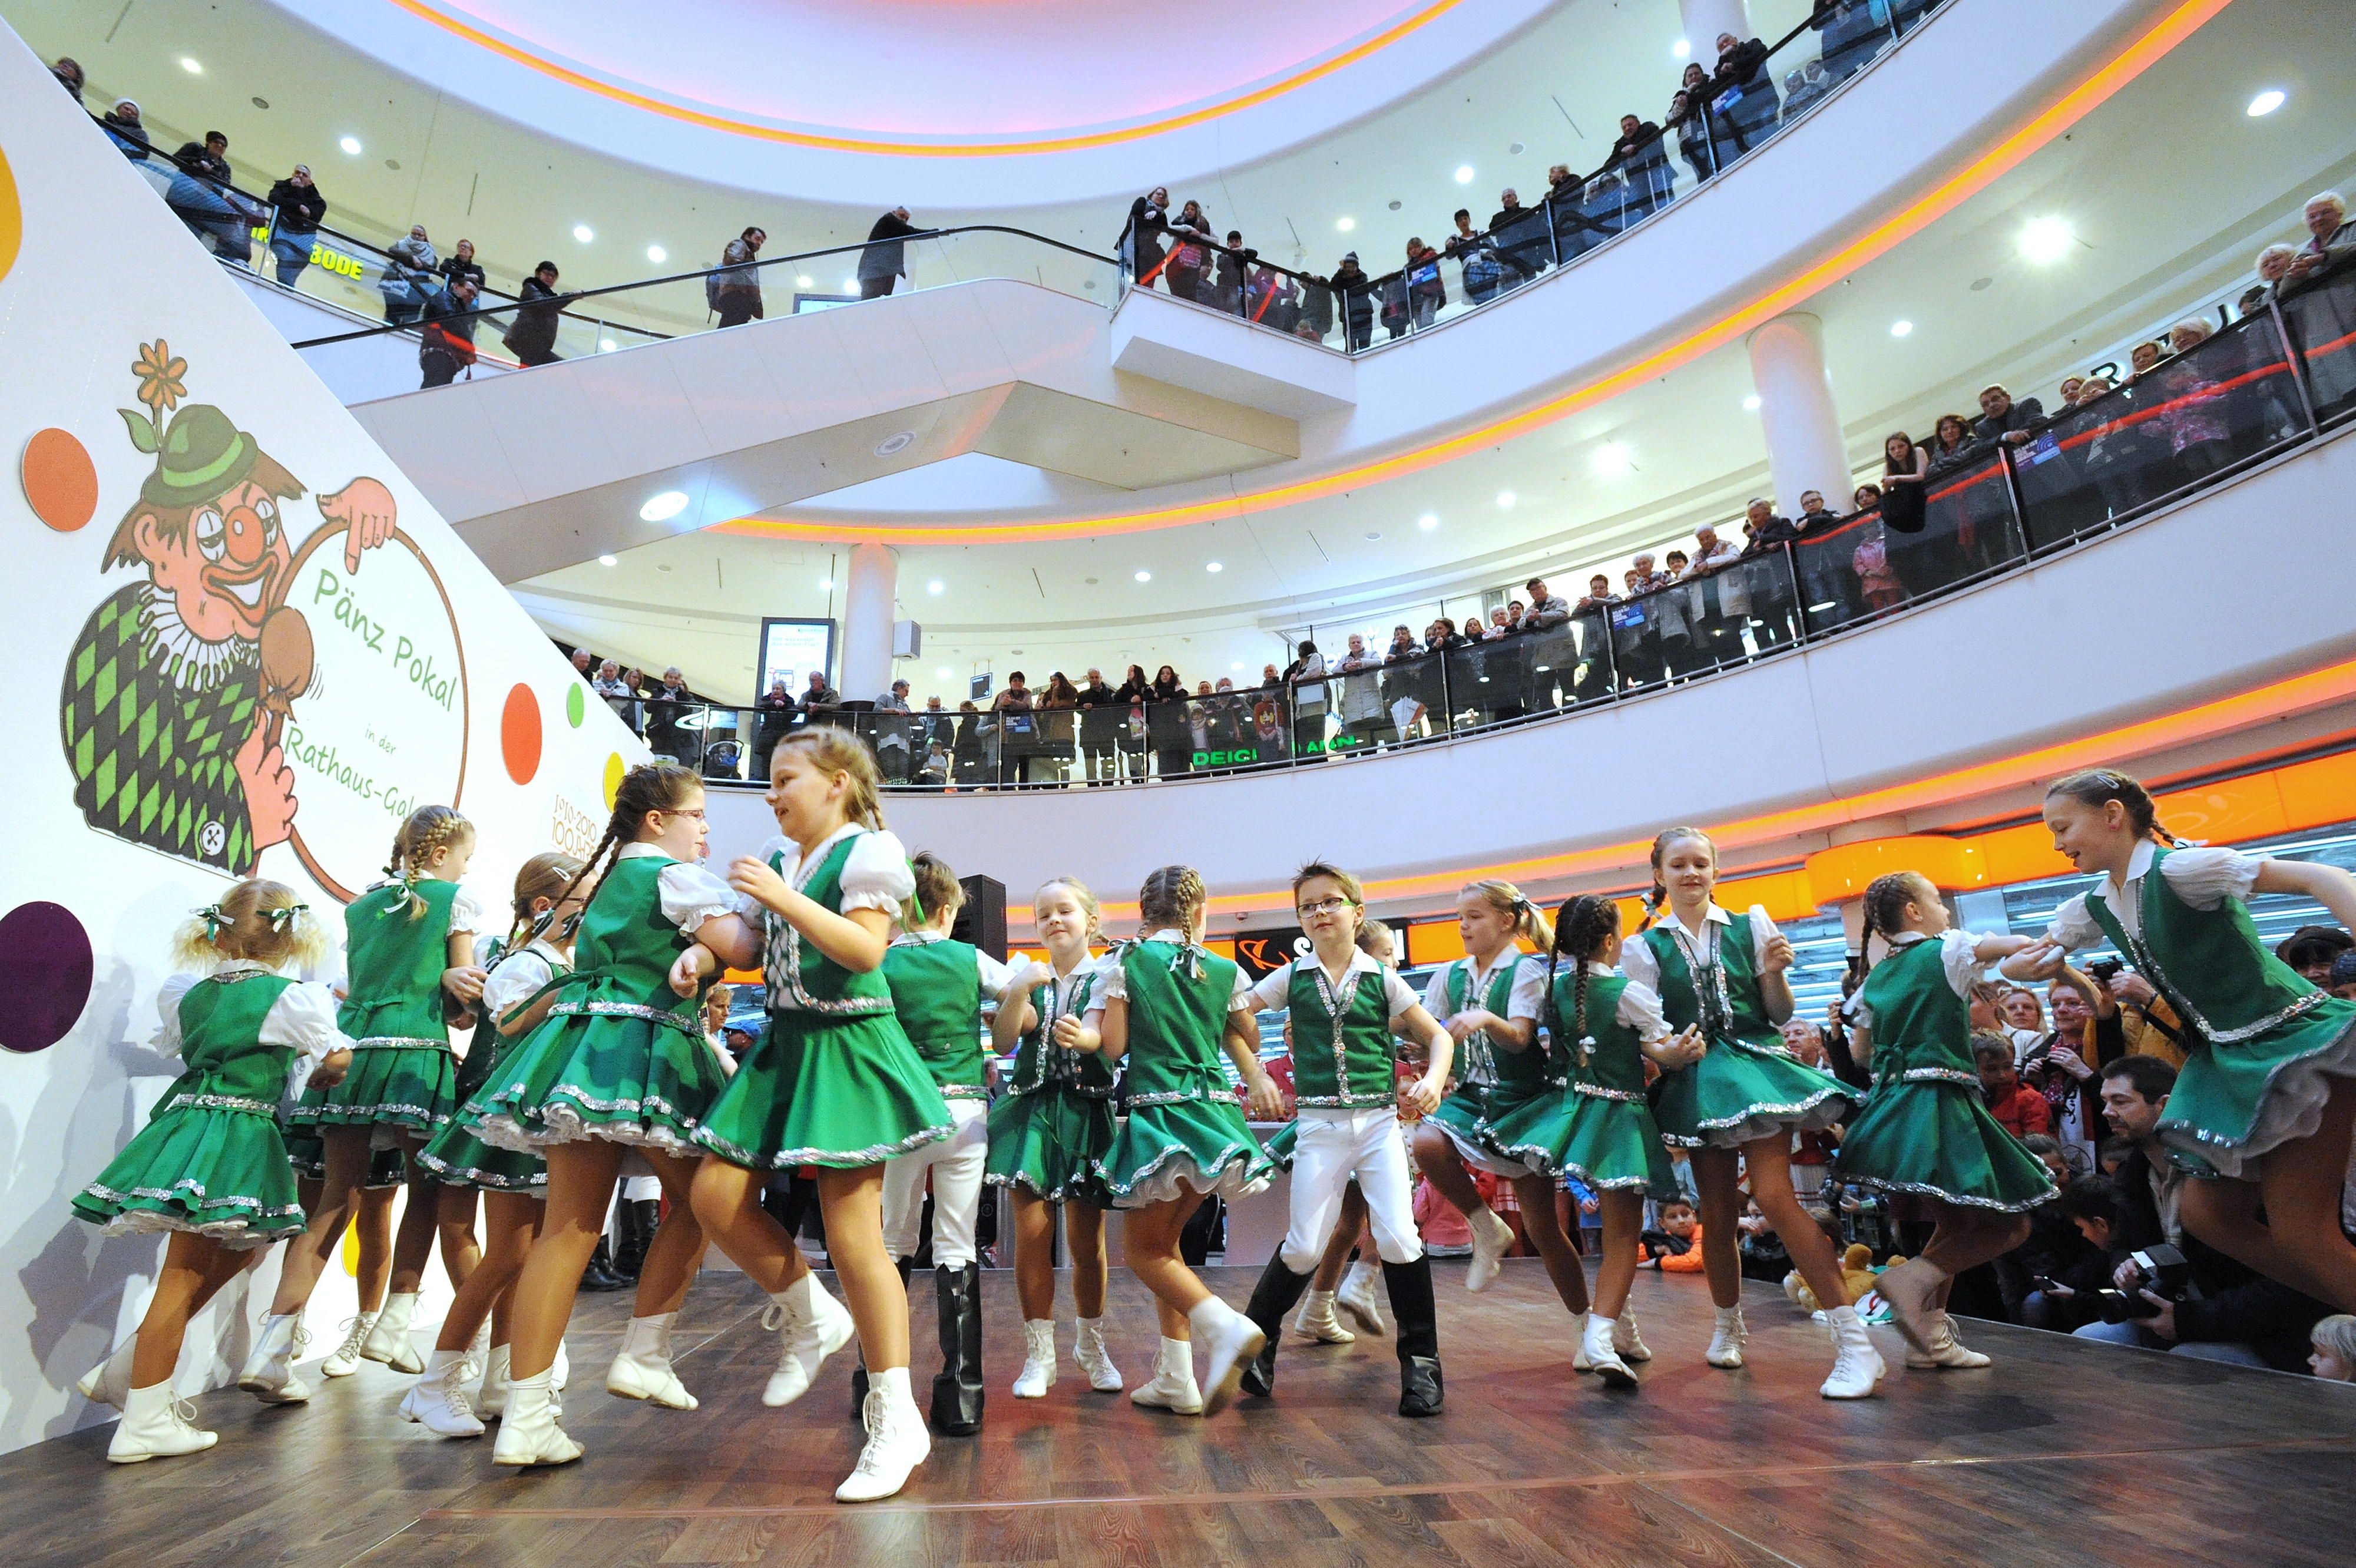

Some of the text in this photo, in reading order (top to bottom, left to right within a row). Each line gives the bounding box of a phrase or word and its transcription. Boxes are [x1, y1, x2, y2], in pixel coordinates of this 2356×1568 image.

[310, 244, 364, 281] BODE
[314, 568, 457, 712] Pänz Pokal
[365, 723, 396, 755] in der
[1193, 735, 1356, 766] DEICANN
